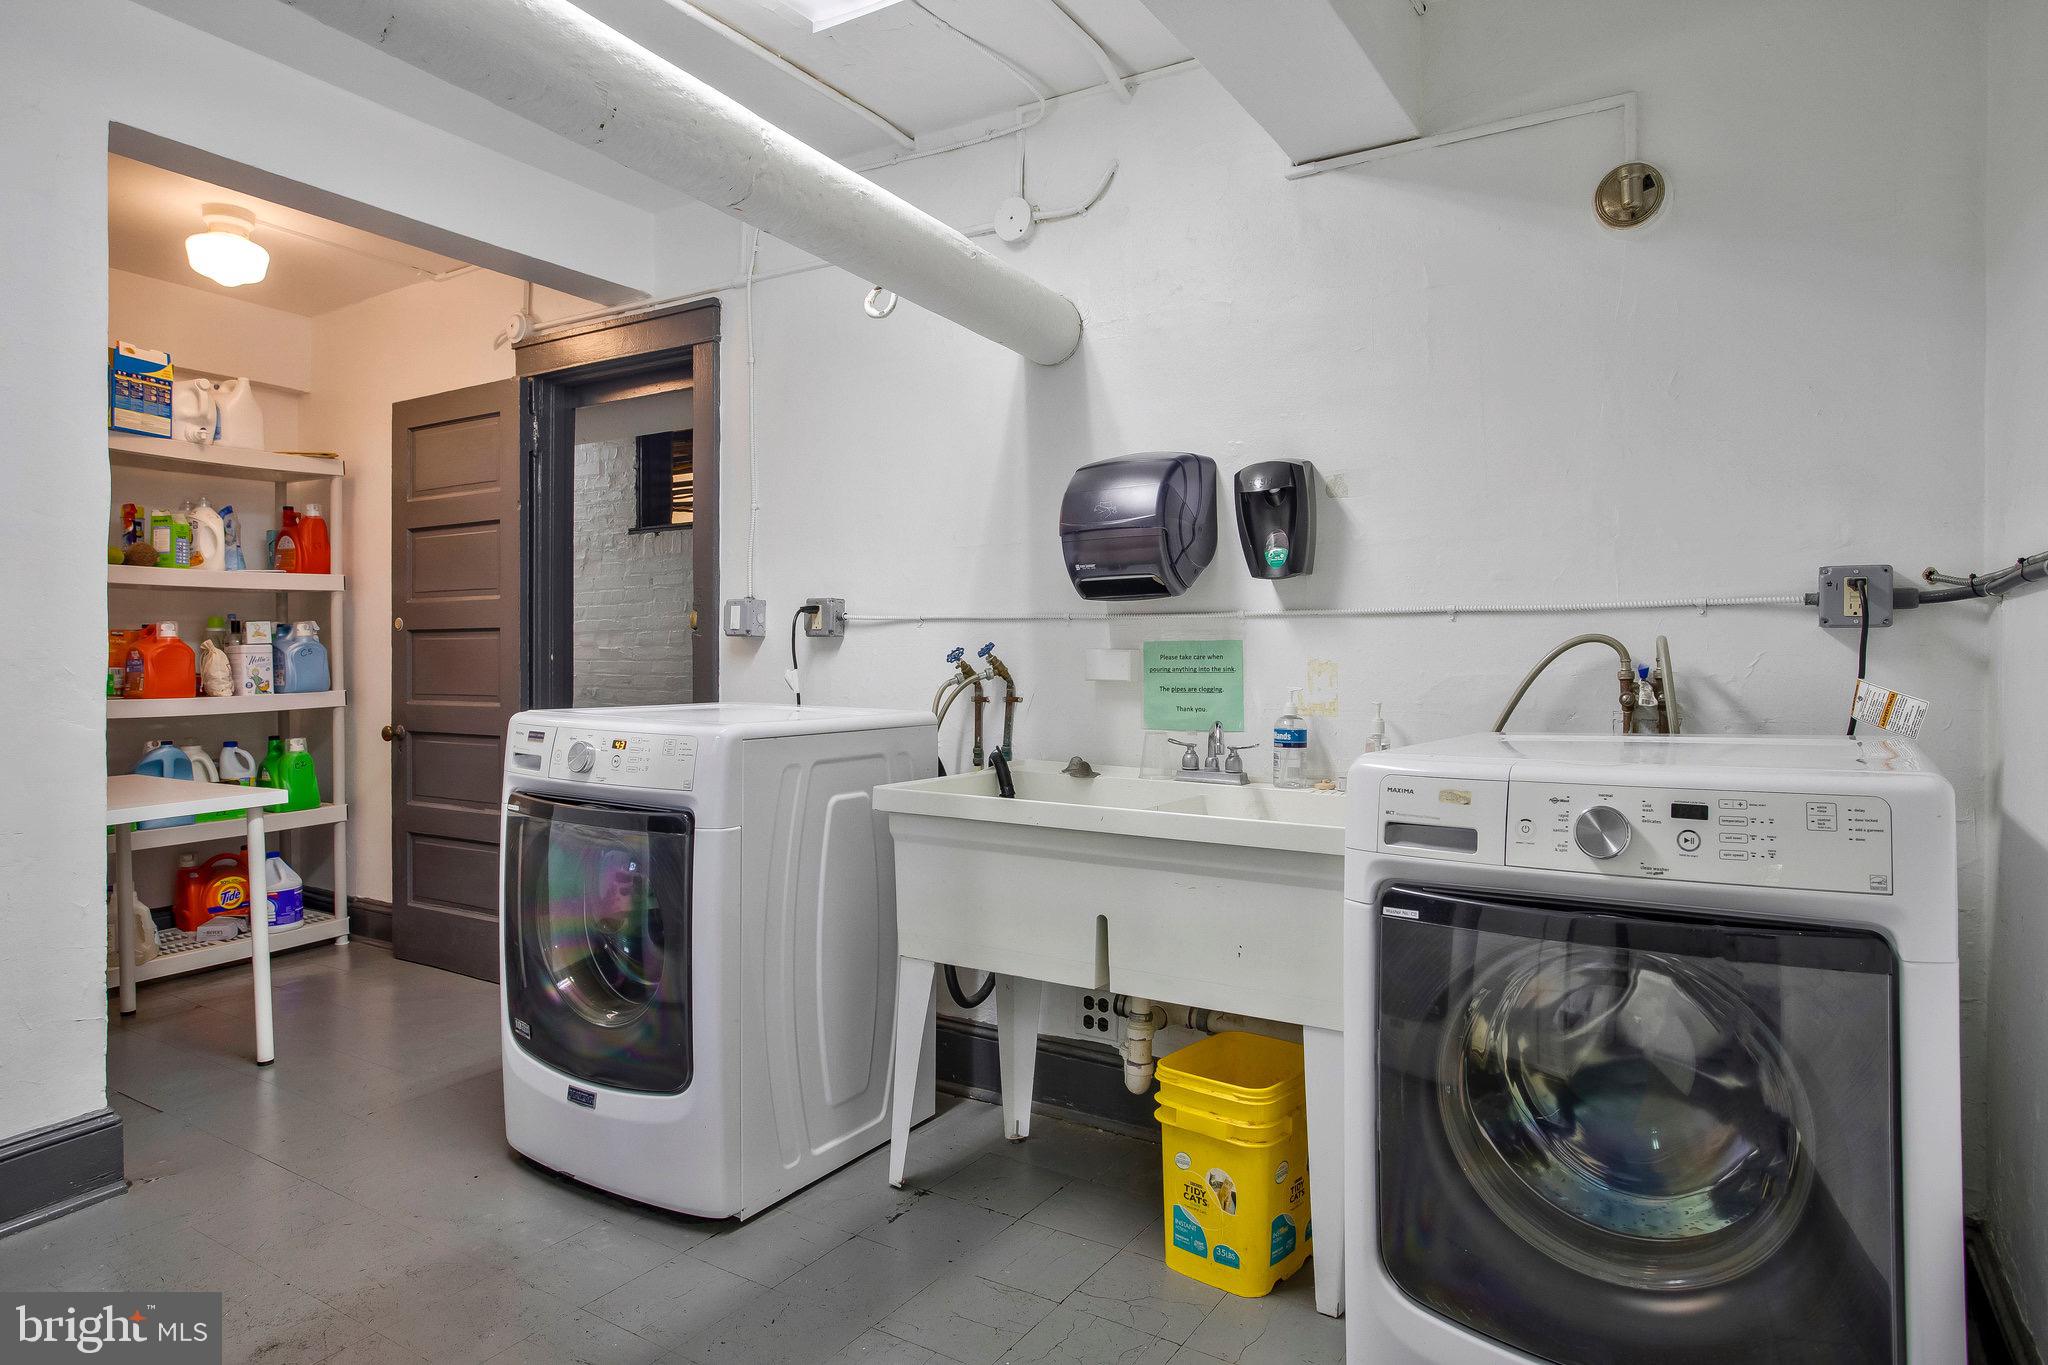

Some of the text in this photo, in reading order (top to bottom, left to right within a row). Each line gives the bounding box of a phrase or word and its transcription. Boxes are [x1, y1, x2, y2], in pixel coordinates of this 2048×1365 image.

[1172, 665, 1198, 673] anything
[615, 741, 625, 750] 43
[1386, 787, 1415, 795] MAXIMA
[221, 889, 241, 905] Tide
[1184, 1183, 1207, 1198] TIDY
[1290, 1181, 1305, 1195] TIDY
[1184, 1192, 1208, 1206] CATS
[1289, 1188, 1305, 1203] CATS
